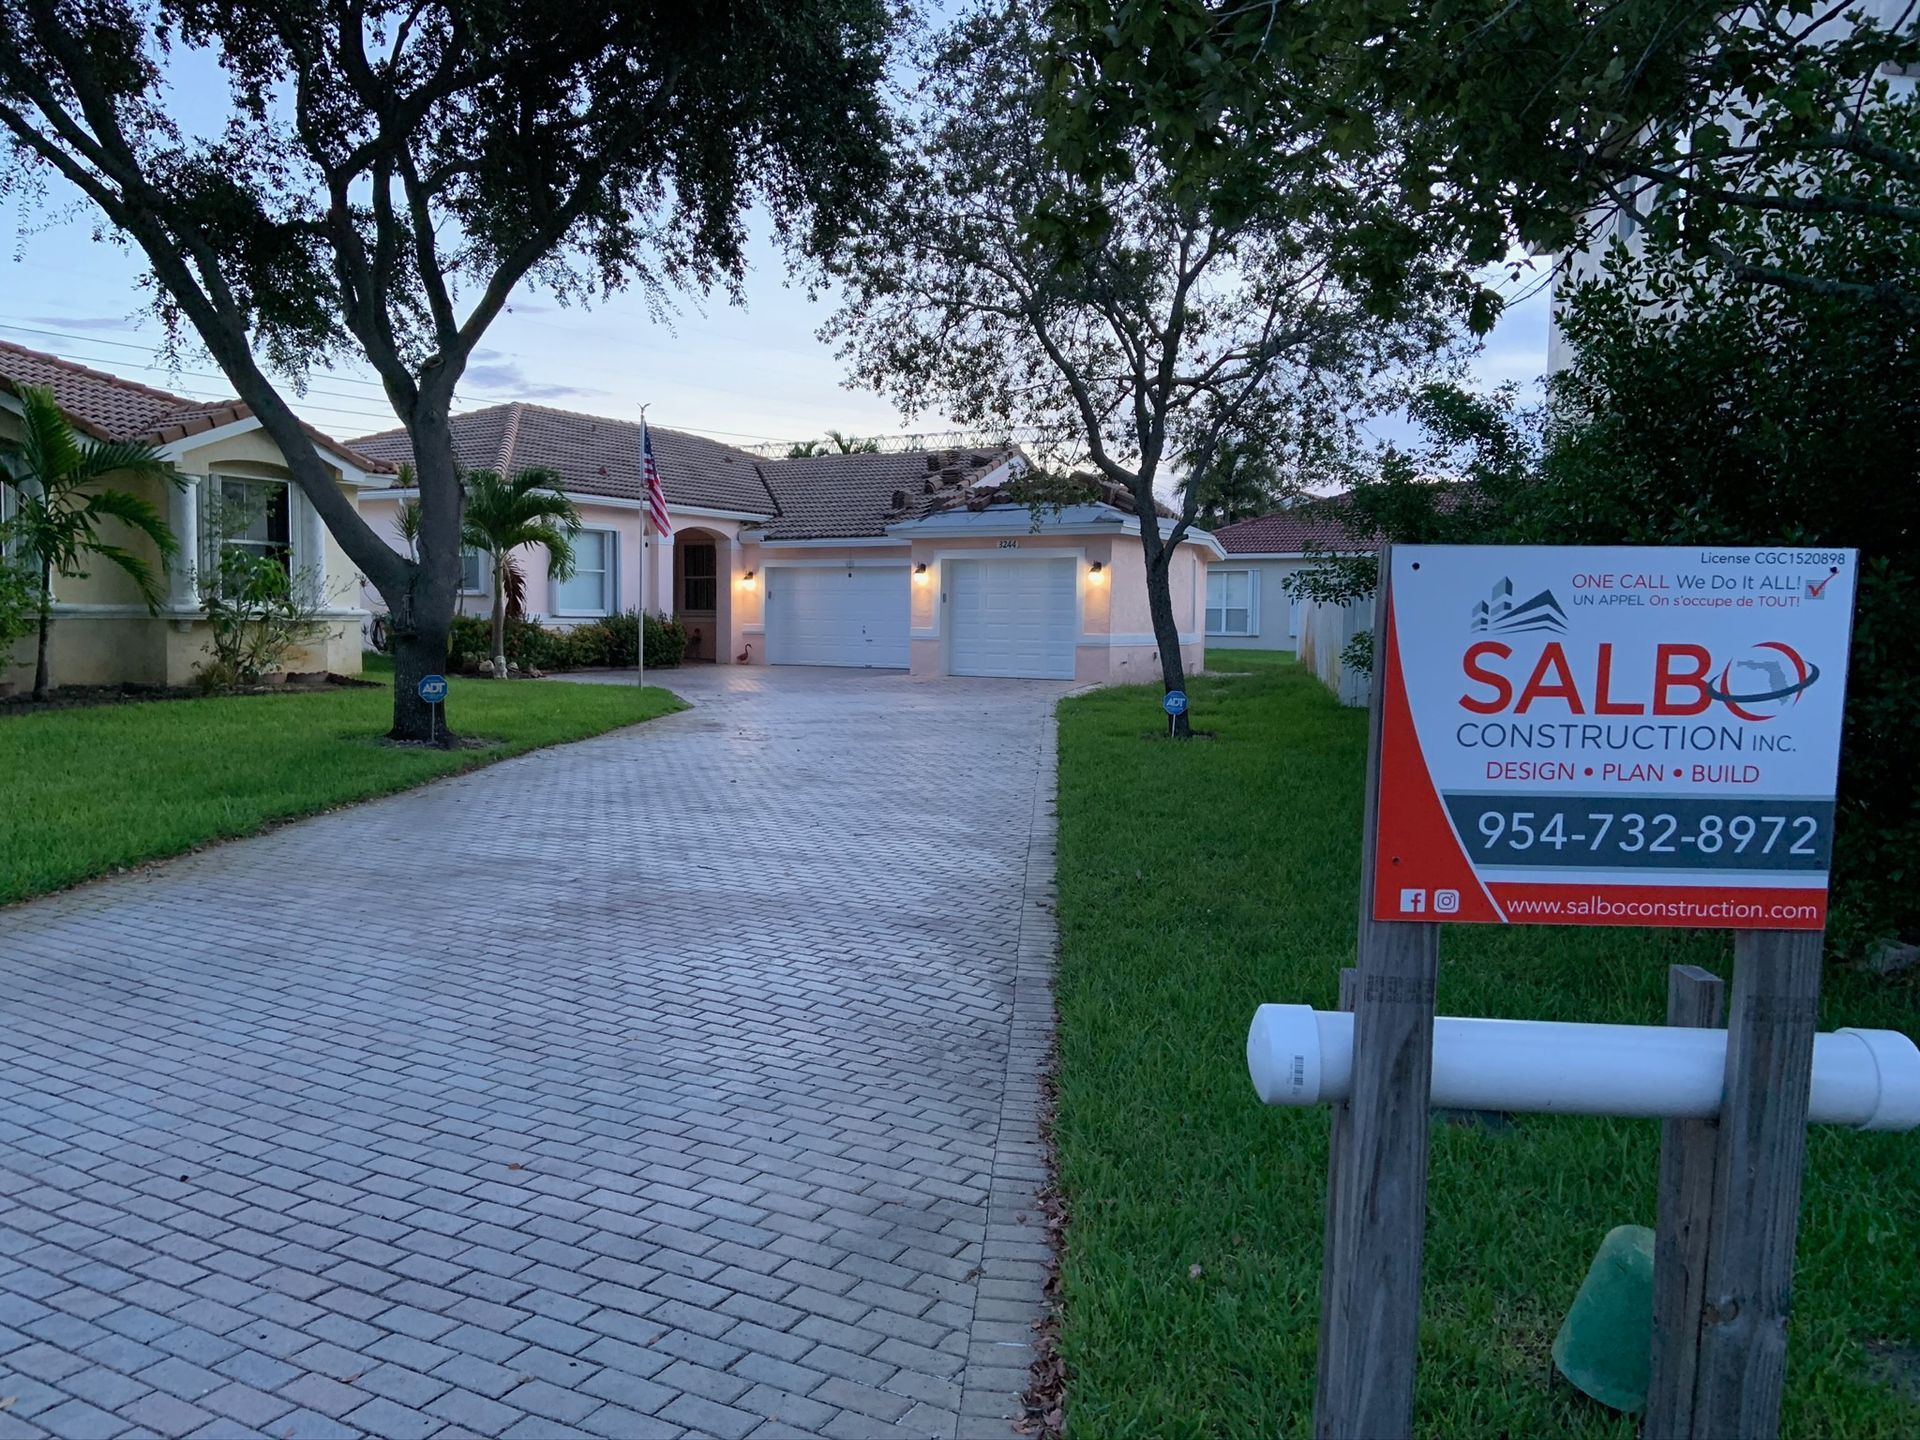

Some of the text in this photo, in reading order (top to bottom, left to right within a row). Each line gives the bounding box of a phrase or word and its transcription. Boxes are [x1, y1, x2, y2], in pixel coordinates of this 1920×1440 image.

[999, 540, 1016, 549] 3244
[1701, 552, 1845, 566] License CGC1520898
[1572, 574, 1801, 591] ONE CALL We Do It ALL!
[1573, 595, 1800, 609] UN APPEL On s'occupe de TOUT!
[422, 682, 445, 693] ADT
[1458, 642, 1806, 721] SALBO
[1166, 697, 1185, 707] ADT
[1457, 723, 1797, 752] CONSTRUCTION INC.
[1486, 762, 1760, 783] DESIGN PLAN BUILD
[1478, 811, 1817, 854] 954-732-8972
[1507, 897, 1817, 920] www.salboconstruction.com
